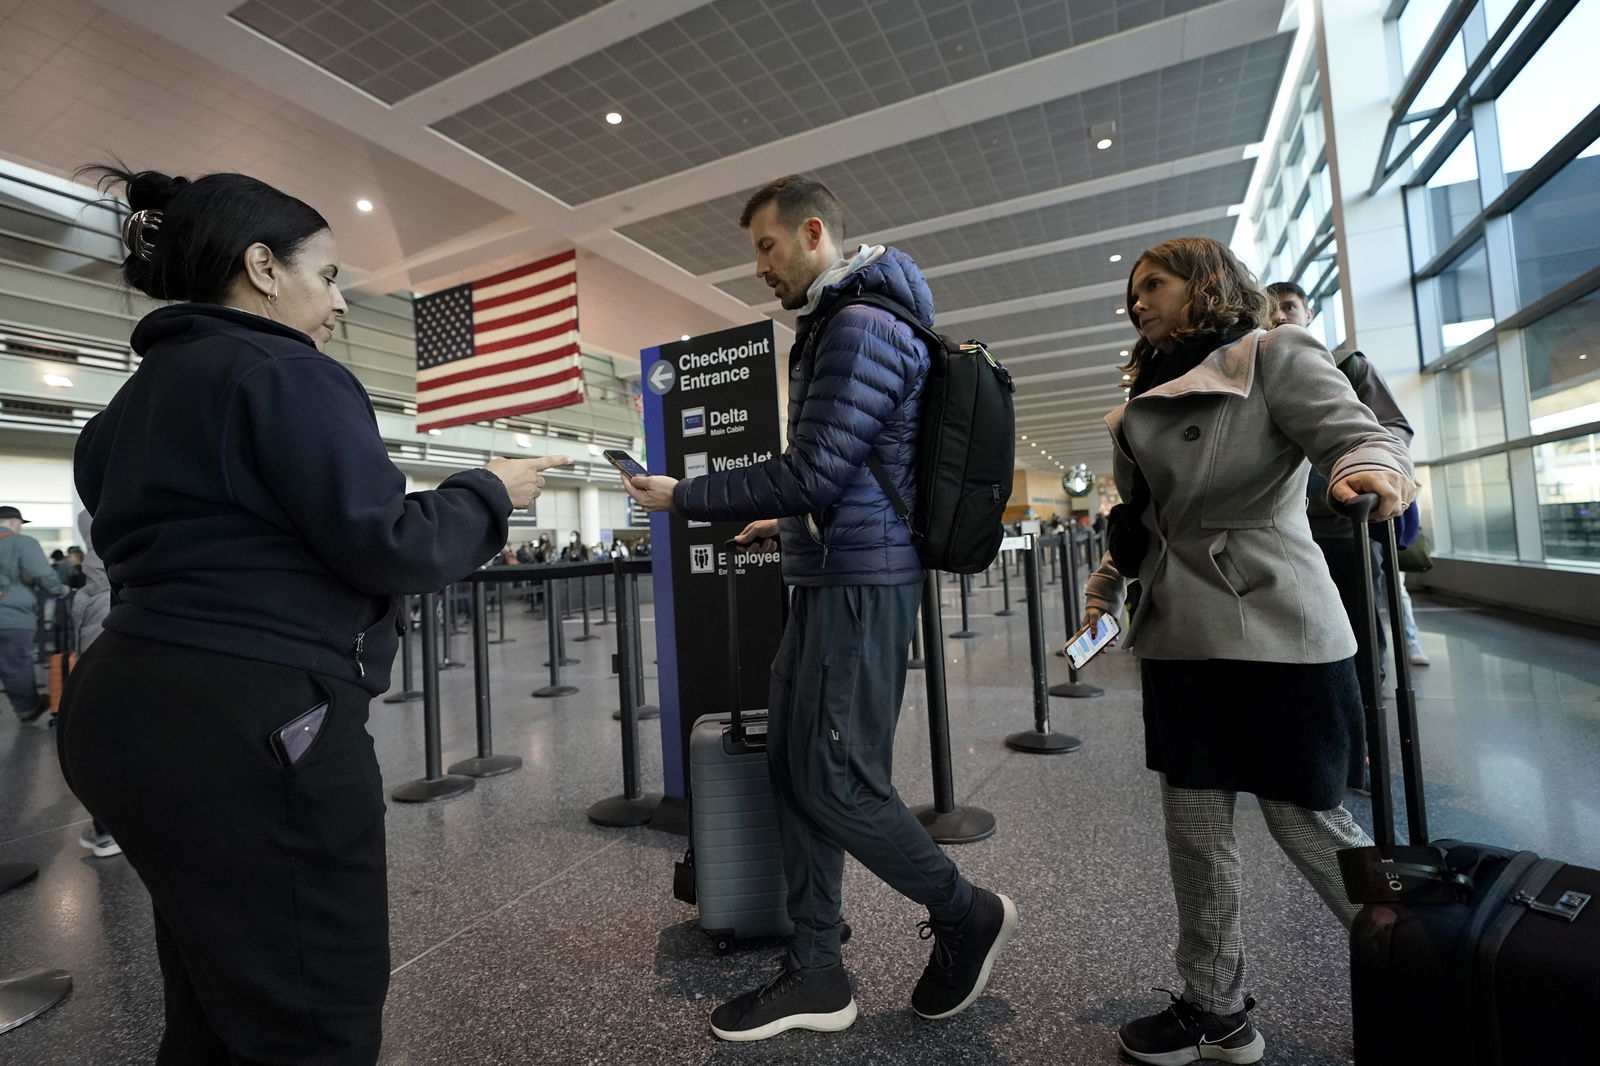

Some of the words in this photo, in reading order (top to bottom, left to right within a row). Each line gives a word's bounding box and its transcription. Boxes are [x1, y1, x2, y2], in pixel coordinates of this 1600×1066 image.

[678, 338, 770, 371] Checkpoint
[680, 366, 750, 391] Entrance
[710, 408, 748, 426] Delta
[710, 428, 726, 436] Main
[726, 425, 745, 434] Cabin
[718, 551, 780, 567] Eployee
